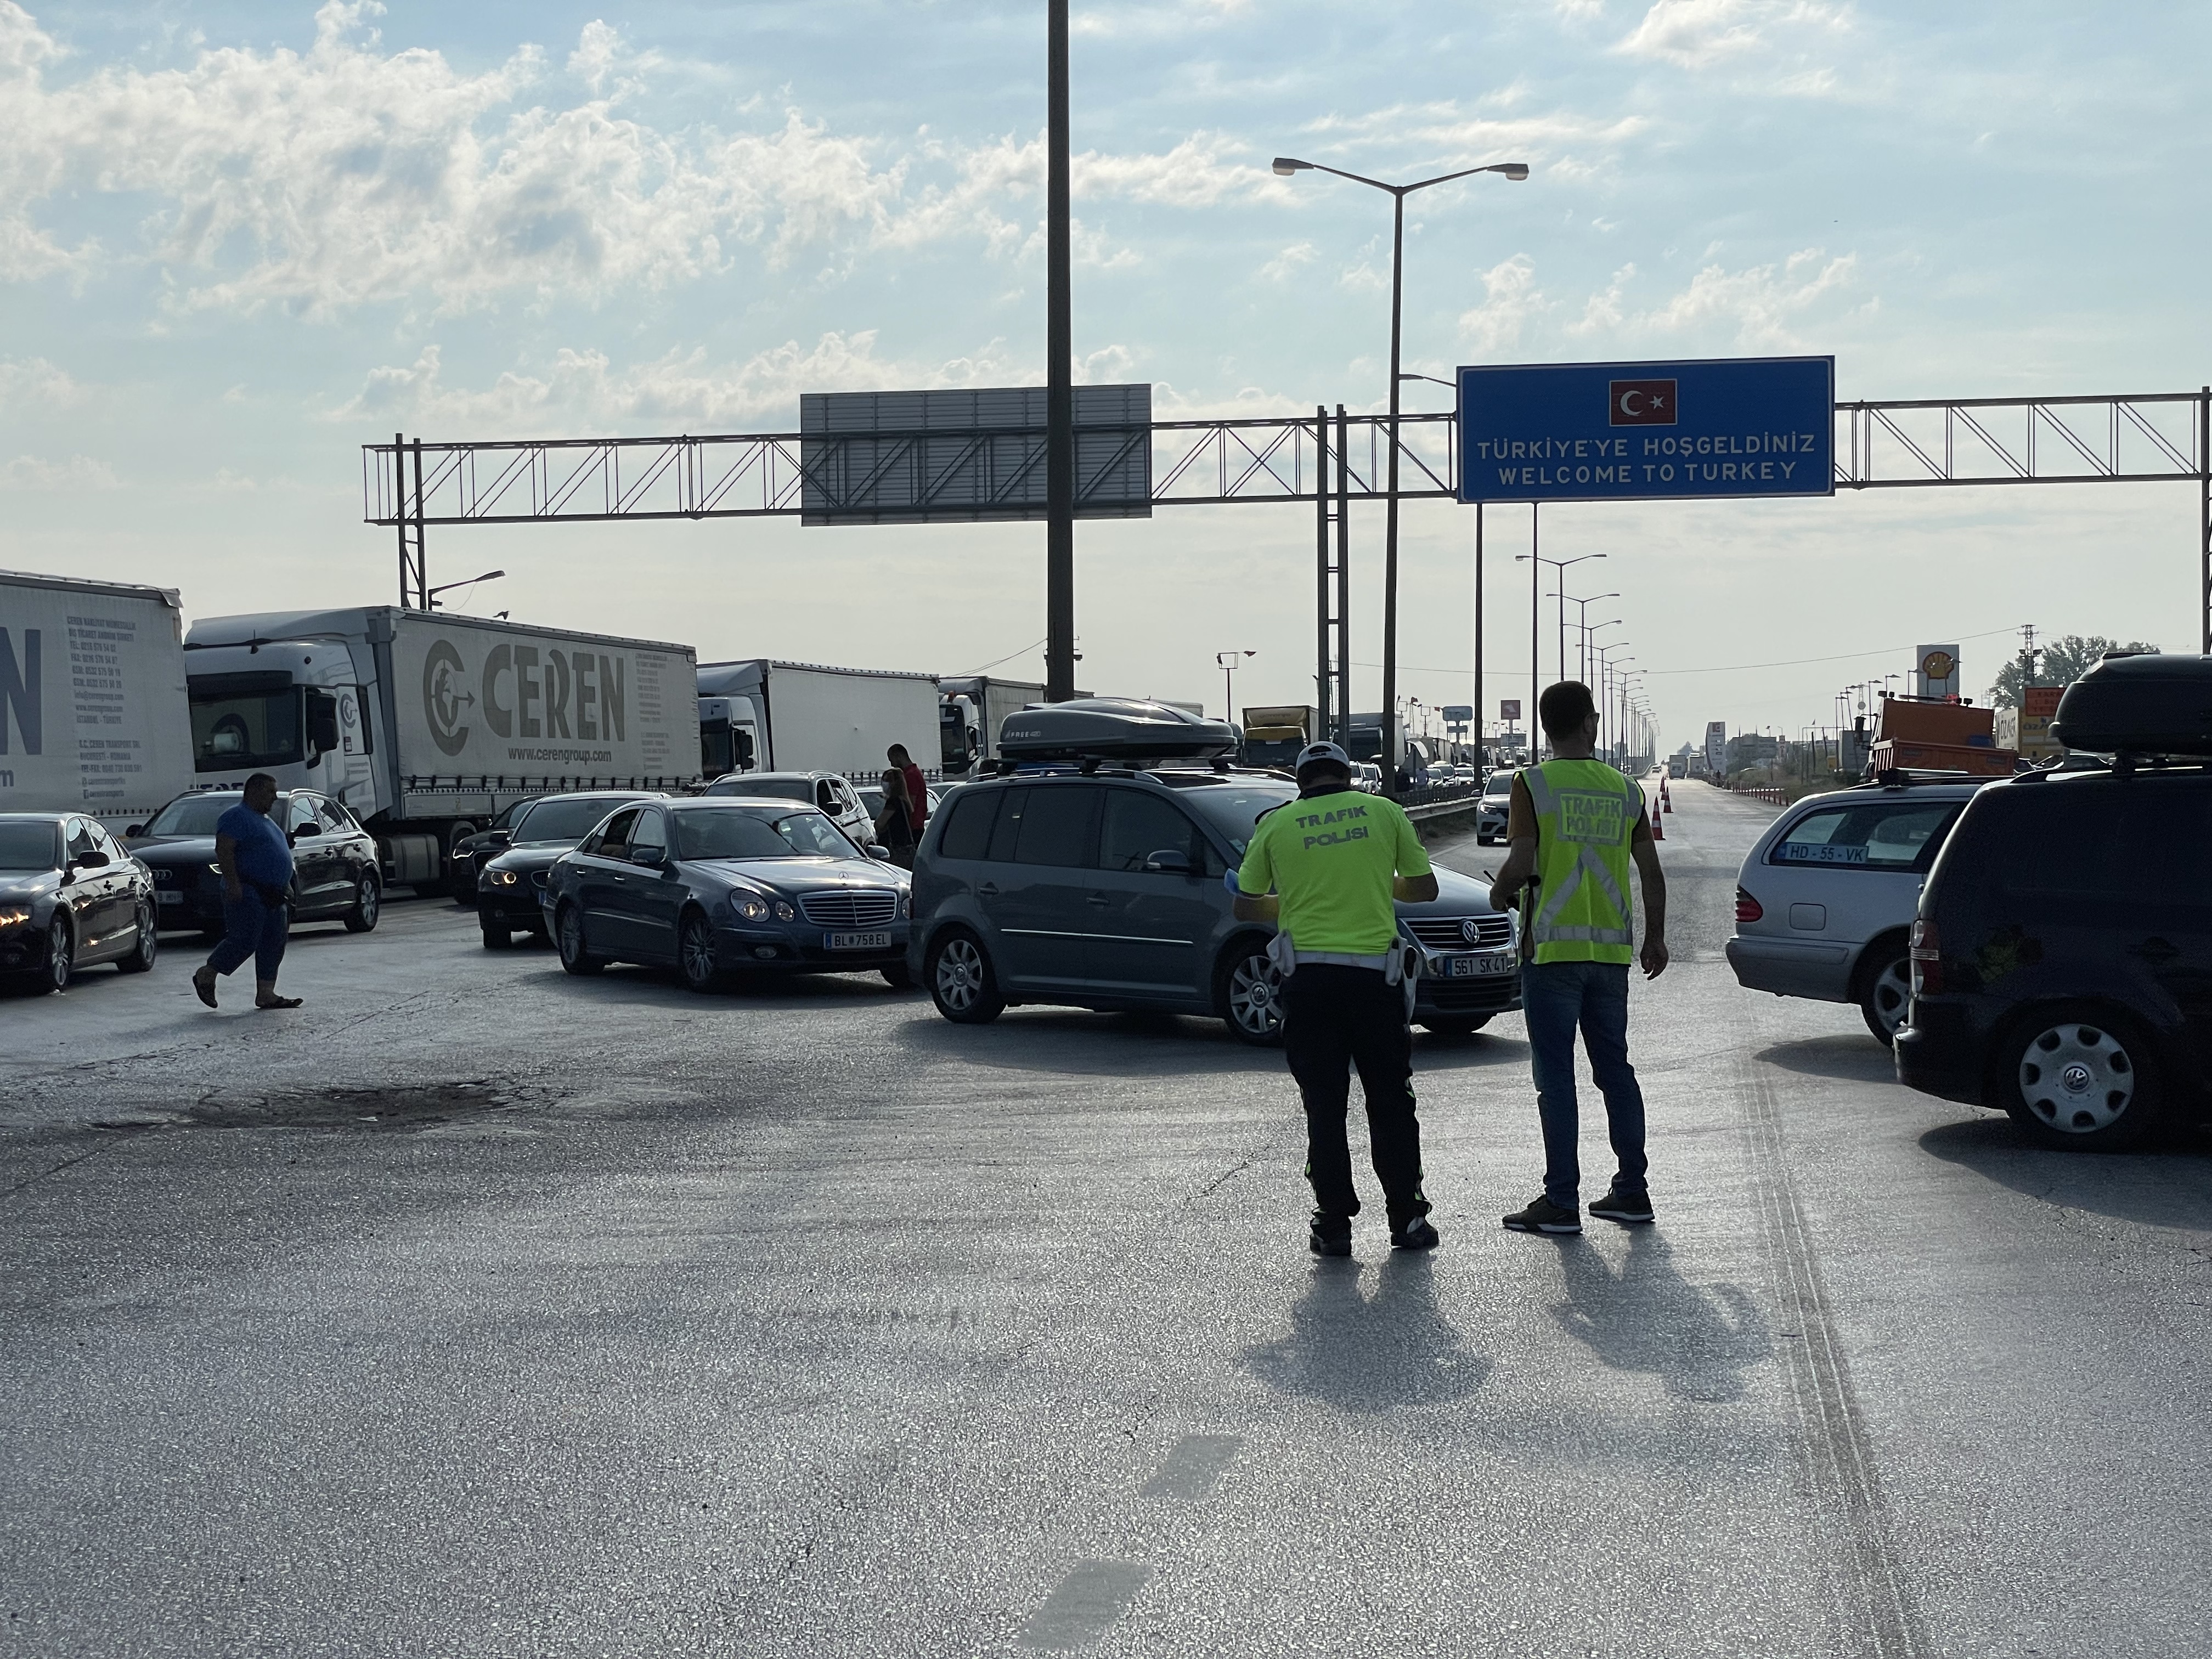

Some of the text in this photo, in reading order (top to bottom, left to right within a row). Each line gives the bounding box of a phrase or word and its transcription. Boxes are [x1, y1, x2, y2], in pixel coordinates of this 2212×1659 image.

[1478, 431, 1815, 460] TÜRKİYE'YE HOŞGELDİNİZ
[1498, 461, 1797, 485] WELCOME TO TURKEY
[483, 644, 625, 742] CEREN
[508, 748, 611, 765] www.cerengroup.com
[1791, 845, 1809, 859] HD
[1820, 847, 1835, 860] 55
[1846, 848, 1864, 861] VK
[834, 934, 887, 946] BL 758 EL
[1455, 958, 1505, 975] 561 SK 41
